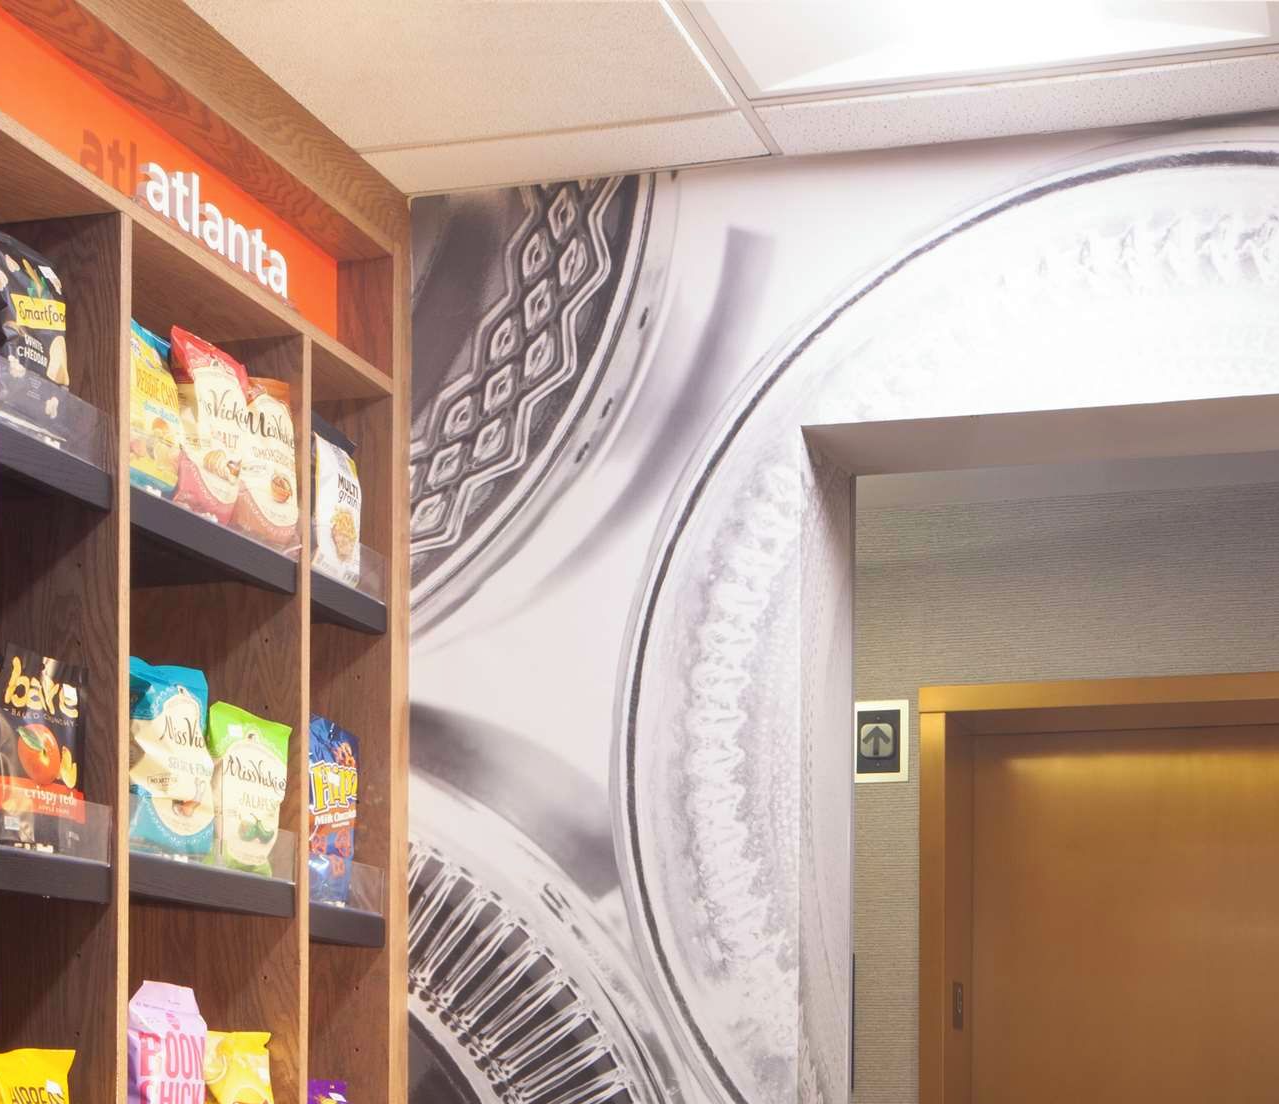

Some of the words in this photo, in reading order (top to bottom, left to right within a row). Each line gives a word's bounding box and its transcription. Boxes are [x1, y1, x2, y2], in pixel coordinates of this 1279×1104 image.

[144, 161, 288, 299] atlanta
[338, 472, 360, 500] MULTI
[4, 656, 79, 719] bare
[24, 785, 58, 807] crispy
[58, 790, 78, 808] red
